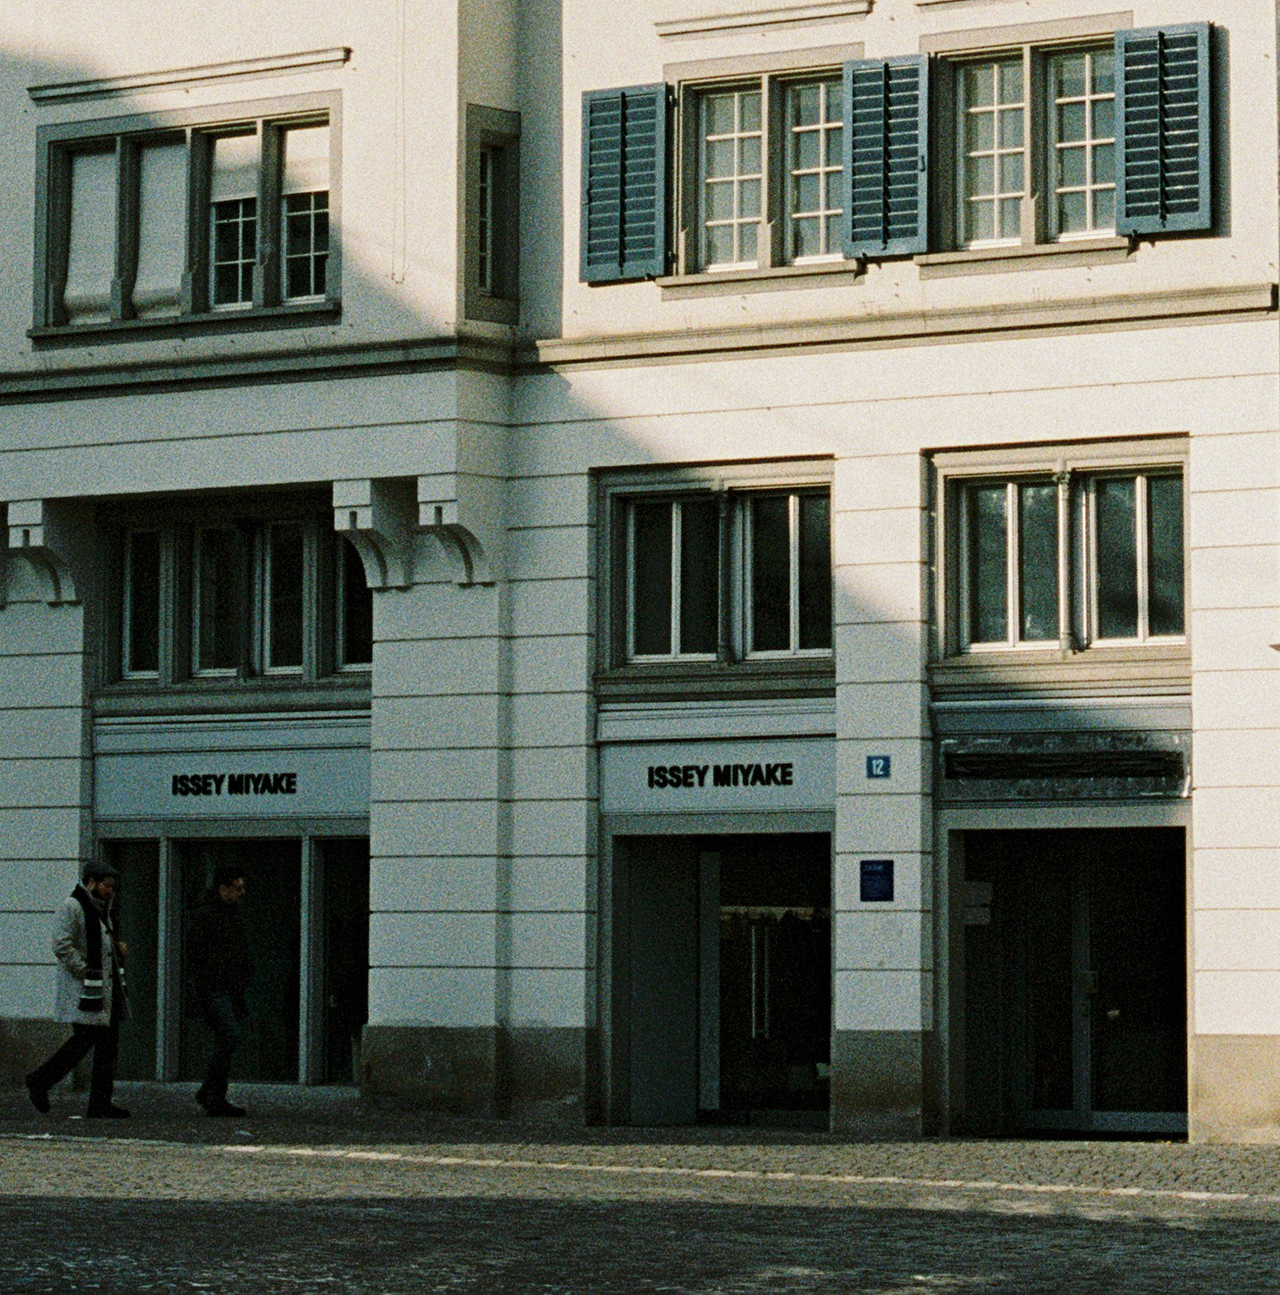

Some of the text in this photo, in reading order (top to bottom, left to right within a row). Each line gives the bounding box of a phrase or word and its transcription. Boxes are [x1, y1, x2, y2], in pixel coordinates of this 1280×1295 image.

[648, 762, 794, 788] ISSEY MIYAKE
[871, 758, 884, 776] 12
[172, 773, 297, 796] ISSEY MIYAKE
